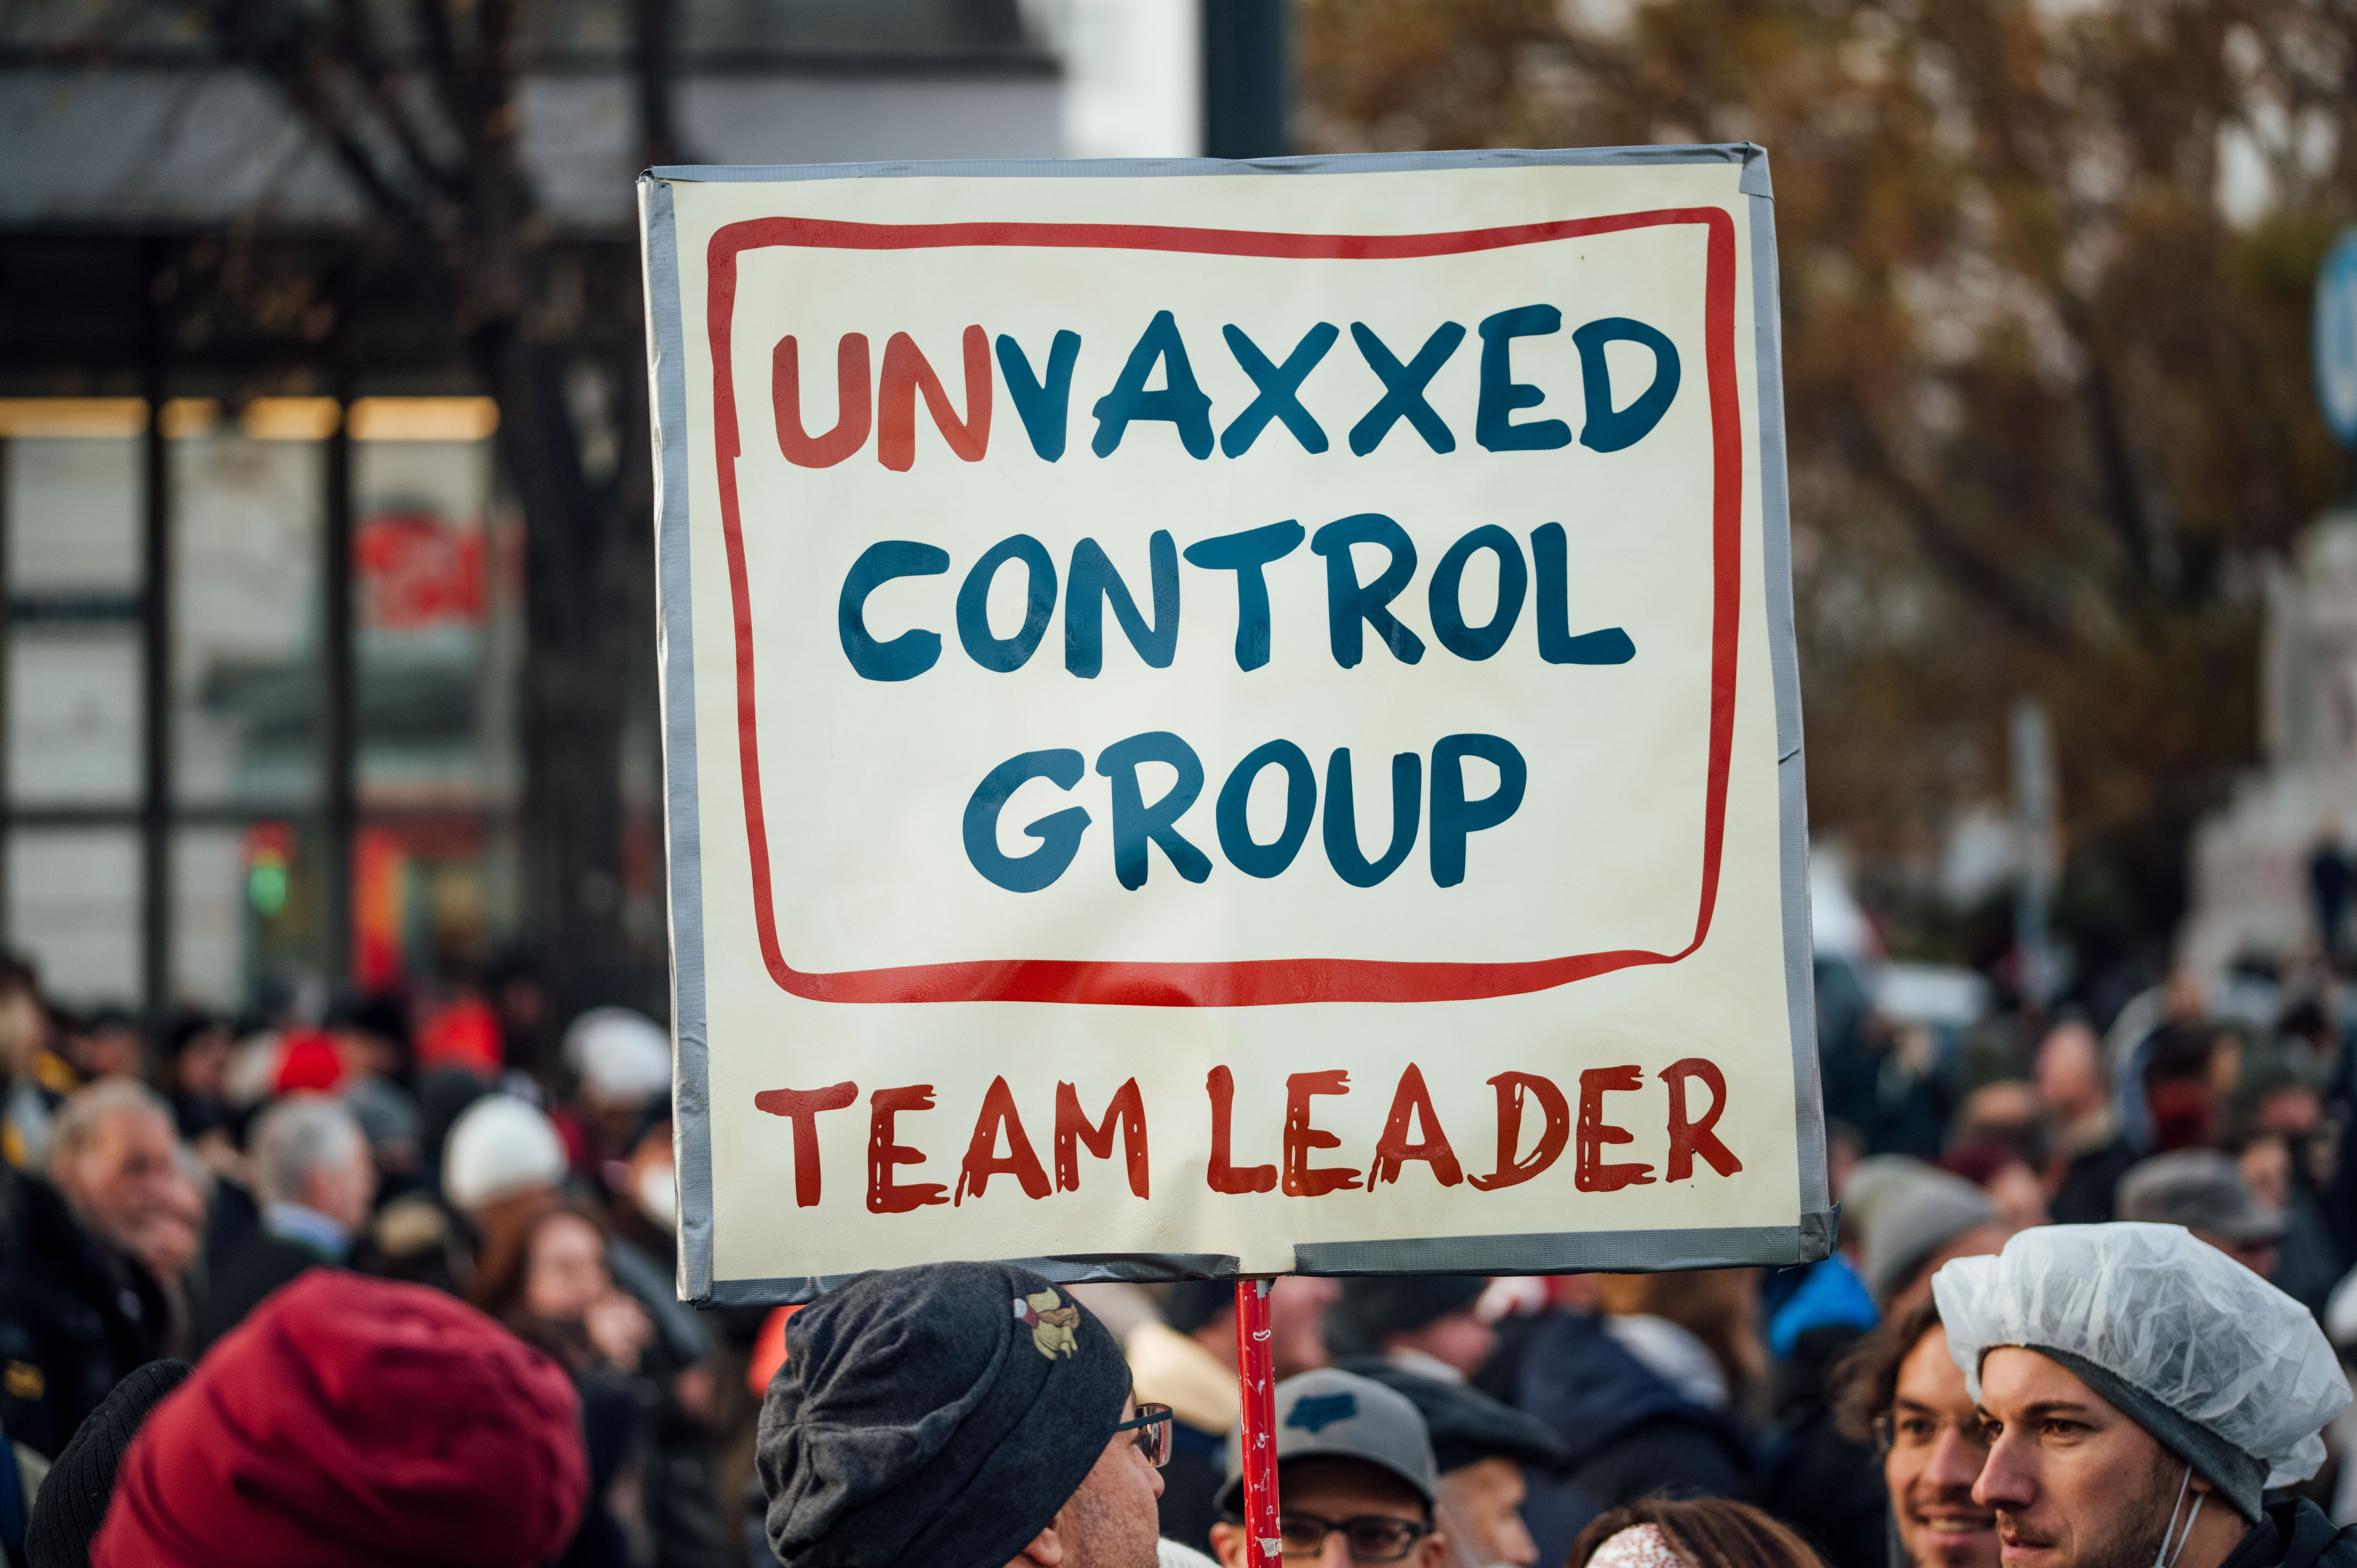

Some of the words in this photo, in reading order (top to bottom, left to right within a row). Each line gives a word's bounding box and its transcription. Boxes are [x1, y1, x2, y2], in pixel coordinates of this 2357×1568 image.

[772, 304, 1681, 473] UNVAXXED
[838, 513, 1636, 682] CONTROL
[962, 731, 1527, 893] GROUP
[754, 1074, 1150, 1215] TEAM
[1205, 1057, 1743, 1198] LEADER
